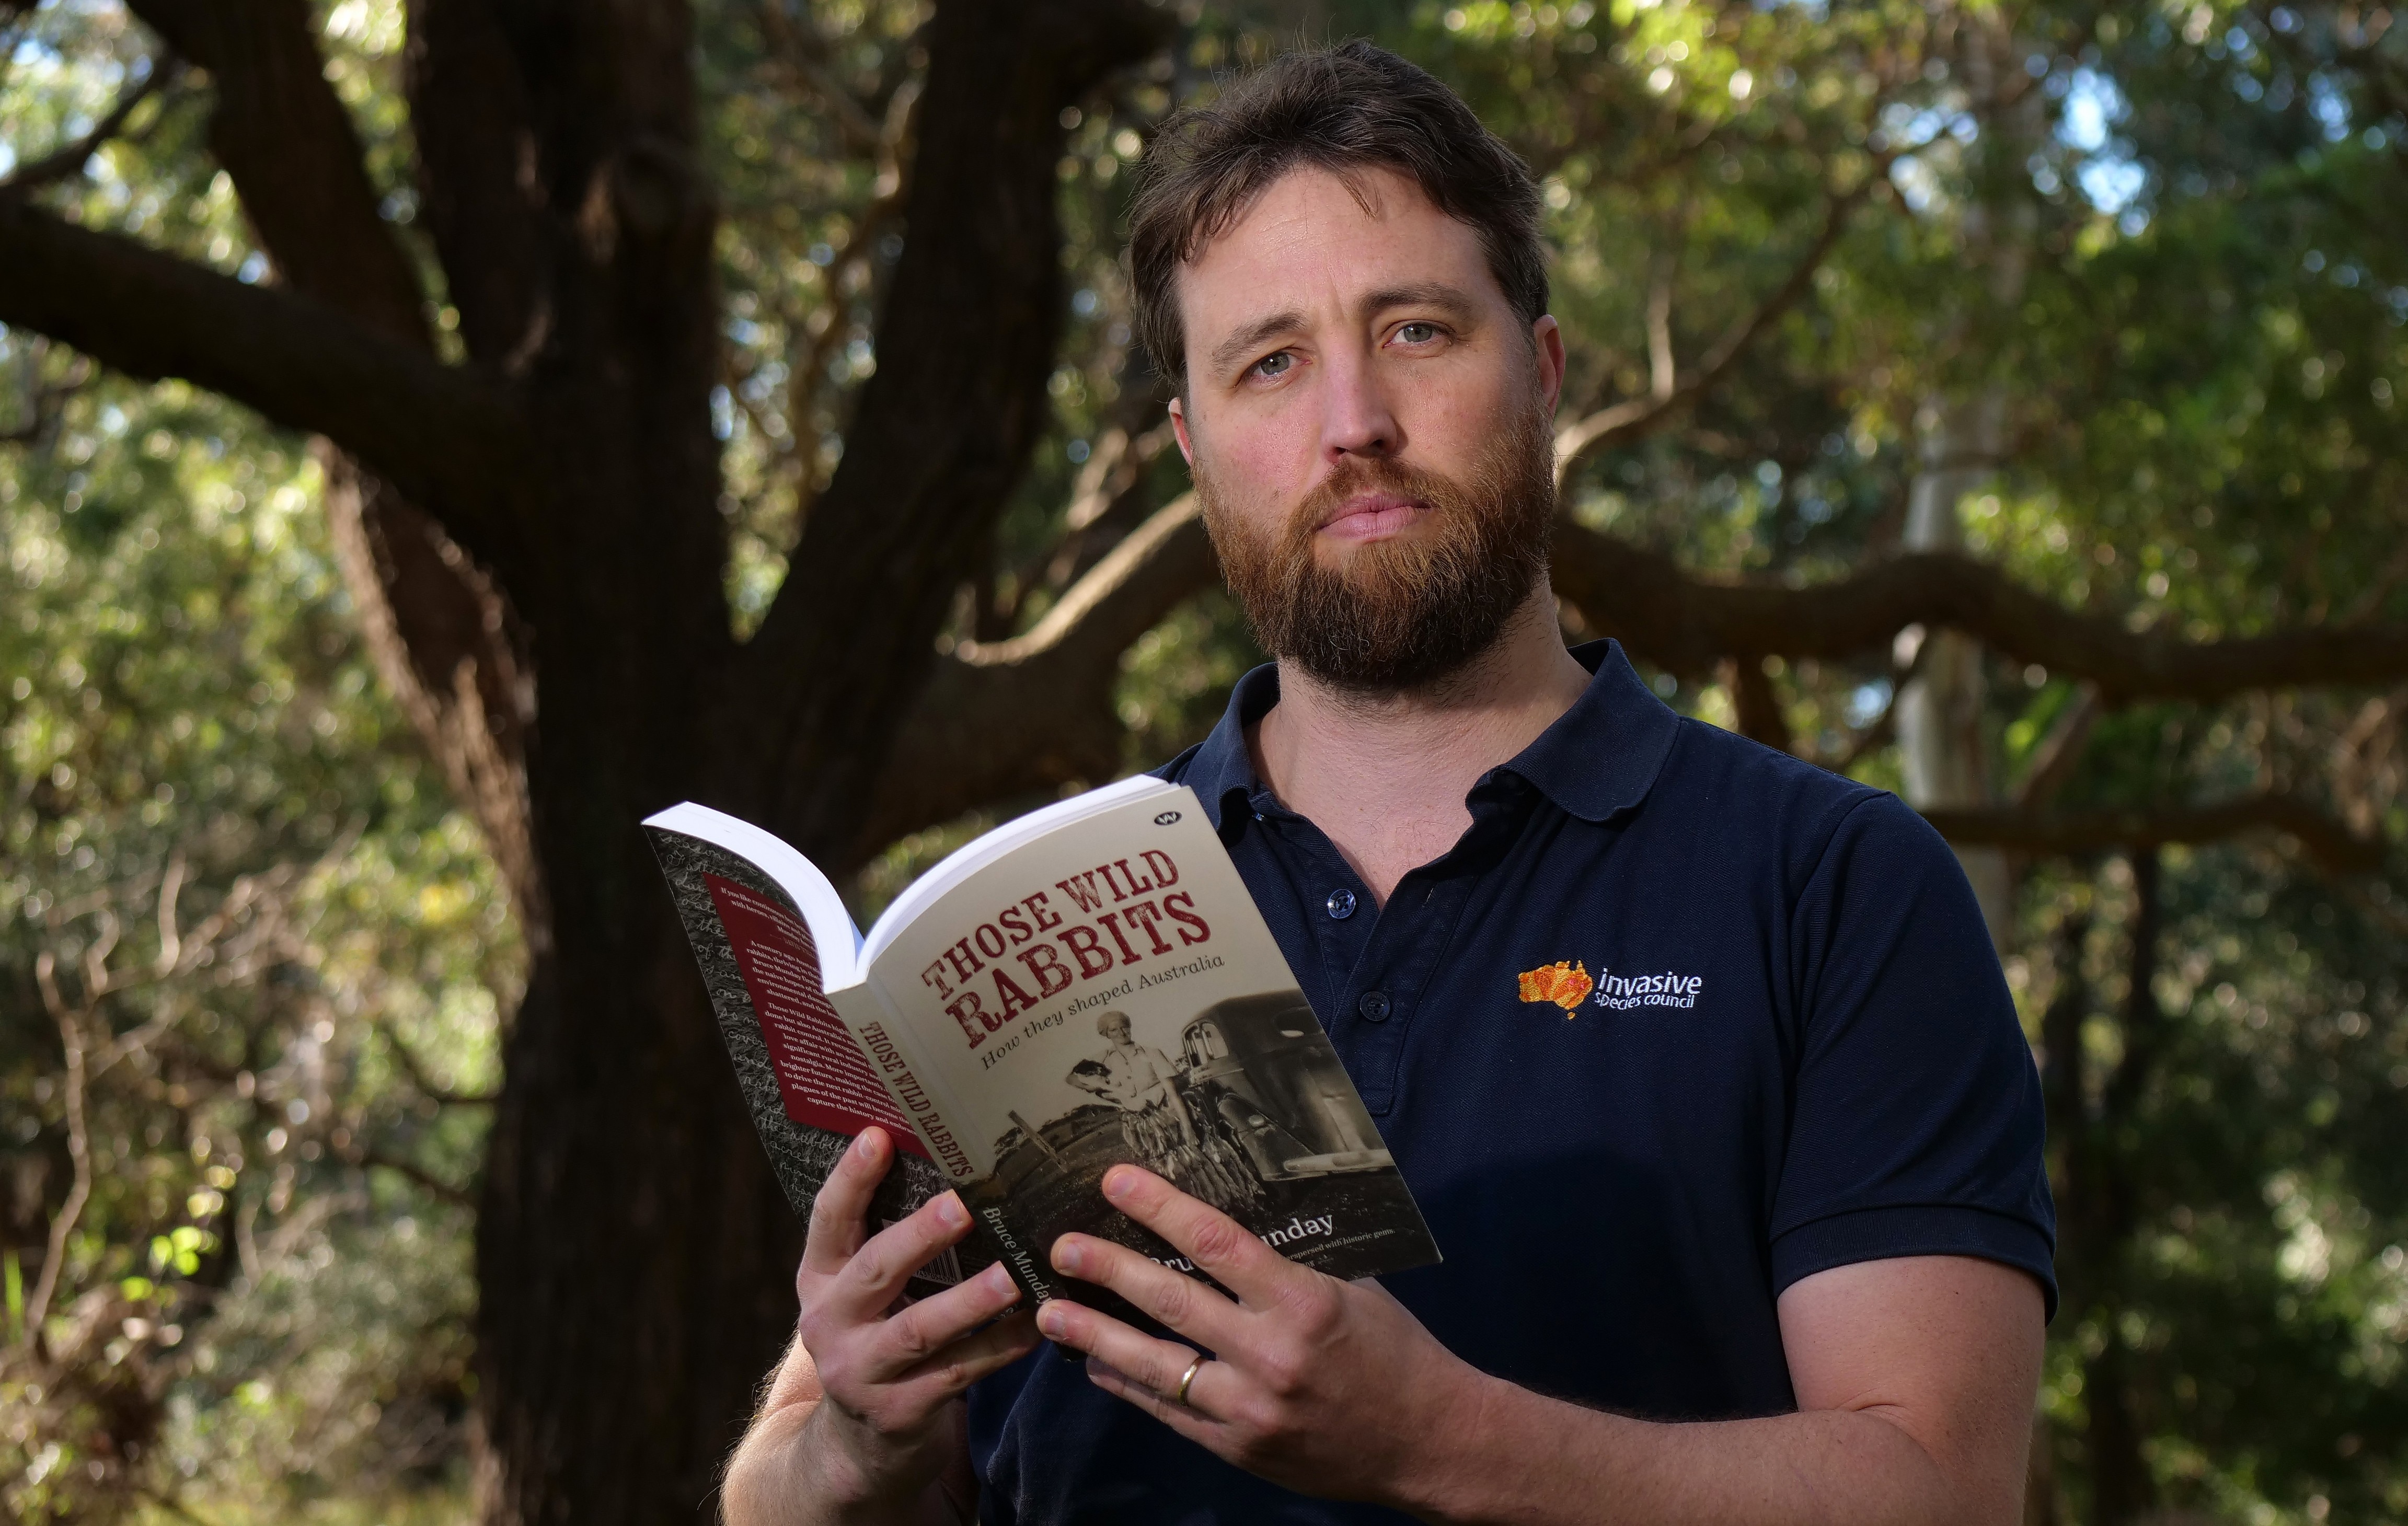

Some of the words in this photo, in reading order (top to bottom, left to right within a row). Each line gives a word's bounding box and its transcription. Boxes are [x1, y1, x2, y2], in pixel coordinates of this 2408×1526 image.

[731, 900, 745, 909] with
[746, 904, 770, 919] heroes,
[739, 894, 751, 903] like
[922, 892, 1063, 1001] THOSE
[1056, 849, 1179, 914] WILD
[746, 949, 774, 961] rabbits,
[773, 956, 801, 973] thriving
[757, 943, 782, 956] century
[753, 957, 774, 969] Bruce
[774, 965, 801, 980] Munday
[753, 966, 764, 975] the
[765, 972, 783, 981] naive
[784, 976, 805, 989] hopes
[946, 891, 1212, 1050] RABBITS
[1598, 967, 1702, 996] invasive
[757, 978, 806, 998] environmental
[767, 988, 802, 1005] shattered,
[815, 1005, 827, 1014] the
[1595, 992, 1641, 1010] species
[1644, 994, 1695, 1008] council
[768, 1002, 788, 1013] Those
[789, 1009, 805, 1019] Wild
[805, 1014, 832, 1028] Rabbits
[981, 1035, 1020, 1070] How
[1024, 1009, 1064, 1040] they
[1067, 980, 1134, 1015] shaped
[1138, 955, 1225, 989] Australia
[765, 1010, 782, 1020] done
[783, 1015, 796, 1024] but
[797, 1021, 811, 1029] also
[812, 1025, 846, 1043] Australia's
[774, 1023, 797, 1033] rabbit
[796, 1030, 825, 1042] control.
[783, 1033, 799, 1042] love
[800, 1039, 820, 1048] affair
[819, 1046, 835, 1054] with
[845, 1054, 868, 1067] animal
[784, 1043, 821, 1058] significant
[821, 1055, 839, 1065] rural
[839, 1059, 868, 1076] industry
[780, 1060, 810, 1073] brighter
[811, 1068, 836, 1081] future,
[835, 1077, 862, 1090] making
[790, 1055, 825, 1068] nostalgia.
[825, 1063, 845, 1074] More
[791, 1083, 820, 1094] plagues
[872, 1105, 899, 1119] become
[793, 1073, 812, 1083] drive
[842, 1088, 890, 1108] rabbit-control
[859, 1020, 906, 1073] THOSE
[892, 1071, 931, 1112] WILD
[918, 1112, 975, 1177] RABBITS
[808, 1097, 835, 1107] capture
[849, 1106, 874, 1119] history
[1260, 1215, 1333, 1246] nday
[1325, 1238, 1342, 1249] with
[1343, 1232, 1373, 1245] historic
[1374, 1228, 1396, 1239] gems.
[983, 1207, 1017, 1250] Bruce
[1010, 1250, 1052, 1304] Munday
